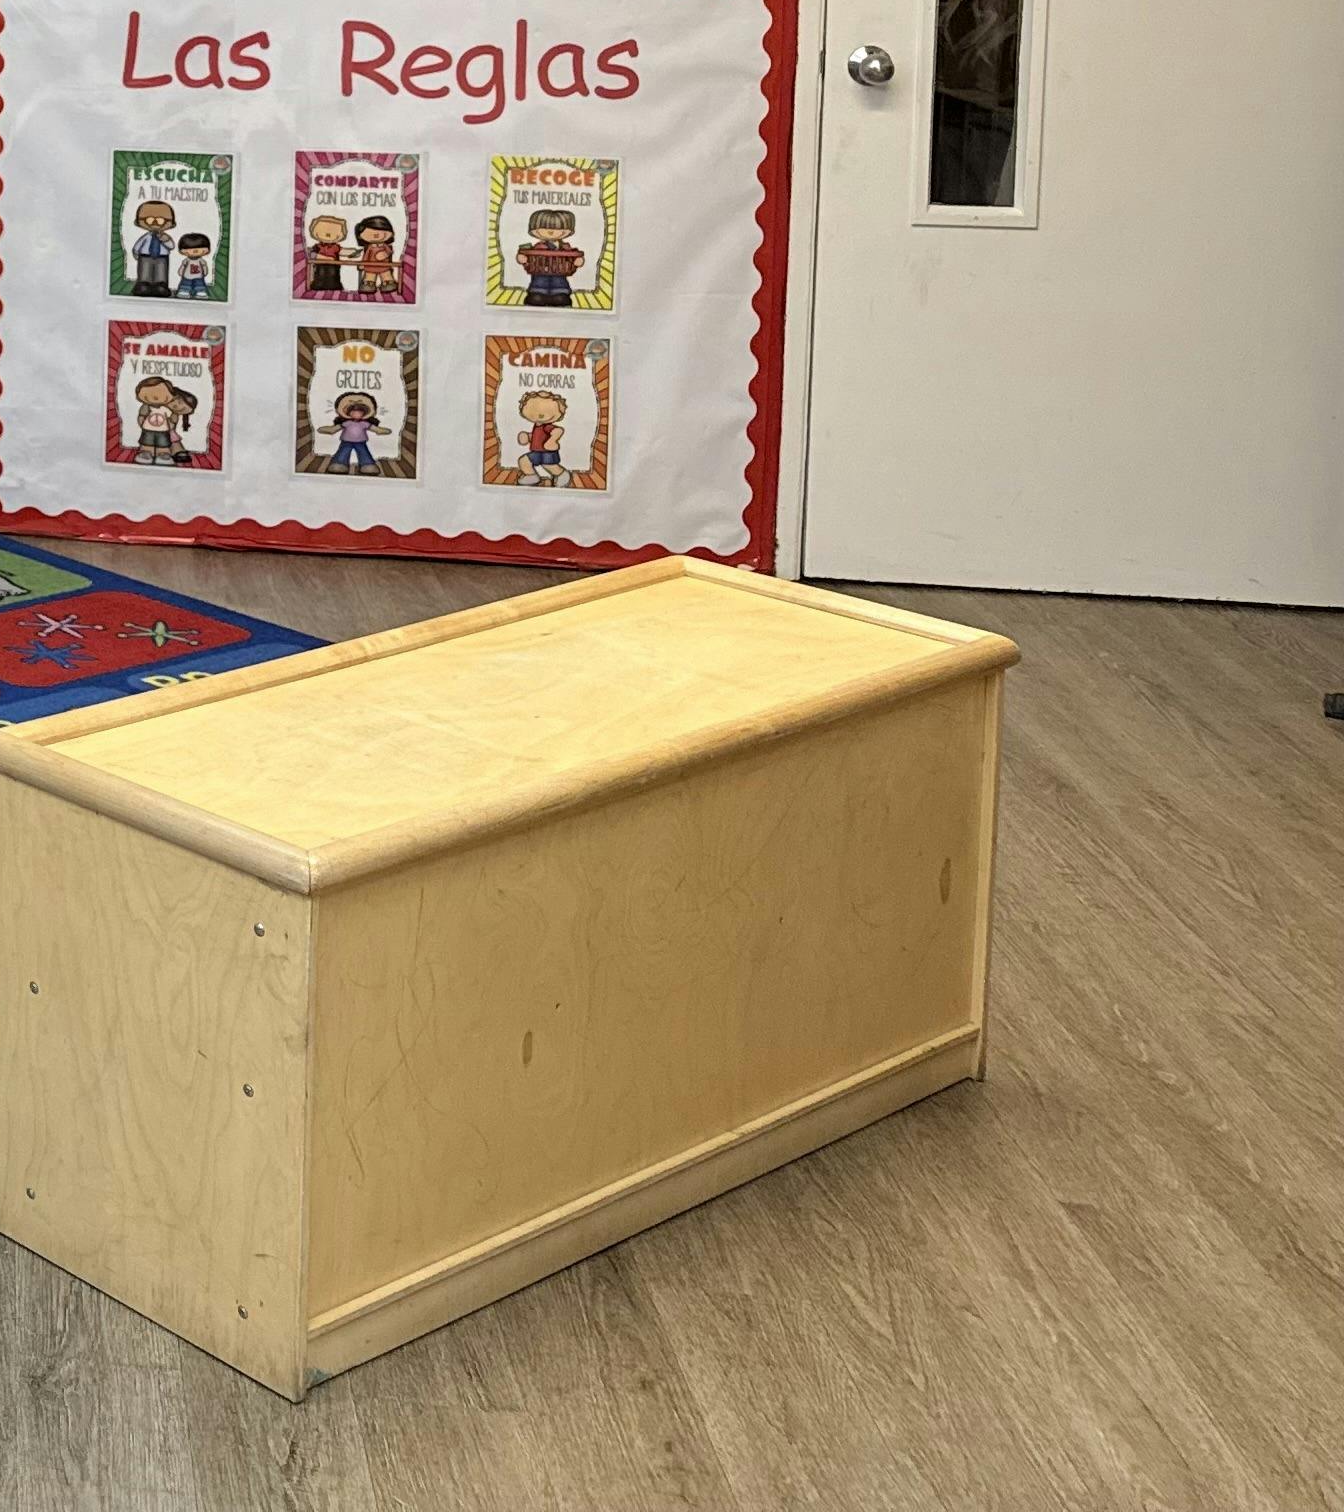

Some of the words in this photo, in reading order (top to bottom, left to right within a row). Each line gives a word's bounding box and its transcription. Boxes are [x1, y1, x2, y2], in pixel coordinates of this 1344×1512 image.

[121, 11, 272, 91] Las
[341, 20, 642, 125] Reglas
[133, 167, 214, 184] ESCUCHA
[313, 175, 400, 189] COMPARTE
[510, 167, 595, 187] RECOGE
[138, 188, 146, 199] A
[151, 188, 162, 200] TU
[164, 188, 209, 202] MAESTRO
[316, 190, 338, 205] CON
[340, 192, 358, 206] LOS
[513, 190, 529, 205] TUS
[531, 190, 591, 207] MATERIALES
[145, 343, 210, 359] AMABLE
[342, 345, 375, 364] NO
[130, 359, 139, 374] Y
[142, 359, 202, 378] RESPETUOSO
[508, 352, 587, 369] CAMINA
[336, 369, 382, 390] GRITES
[518, 372, 534, 388] NO
[537, 372, 576, 389] CORRAS
